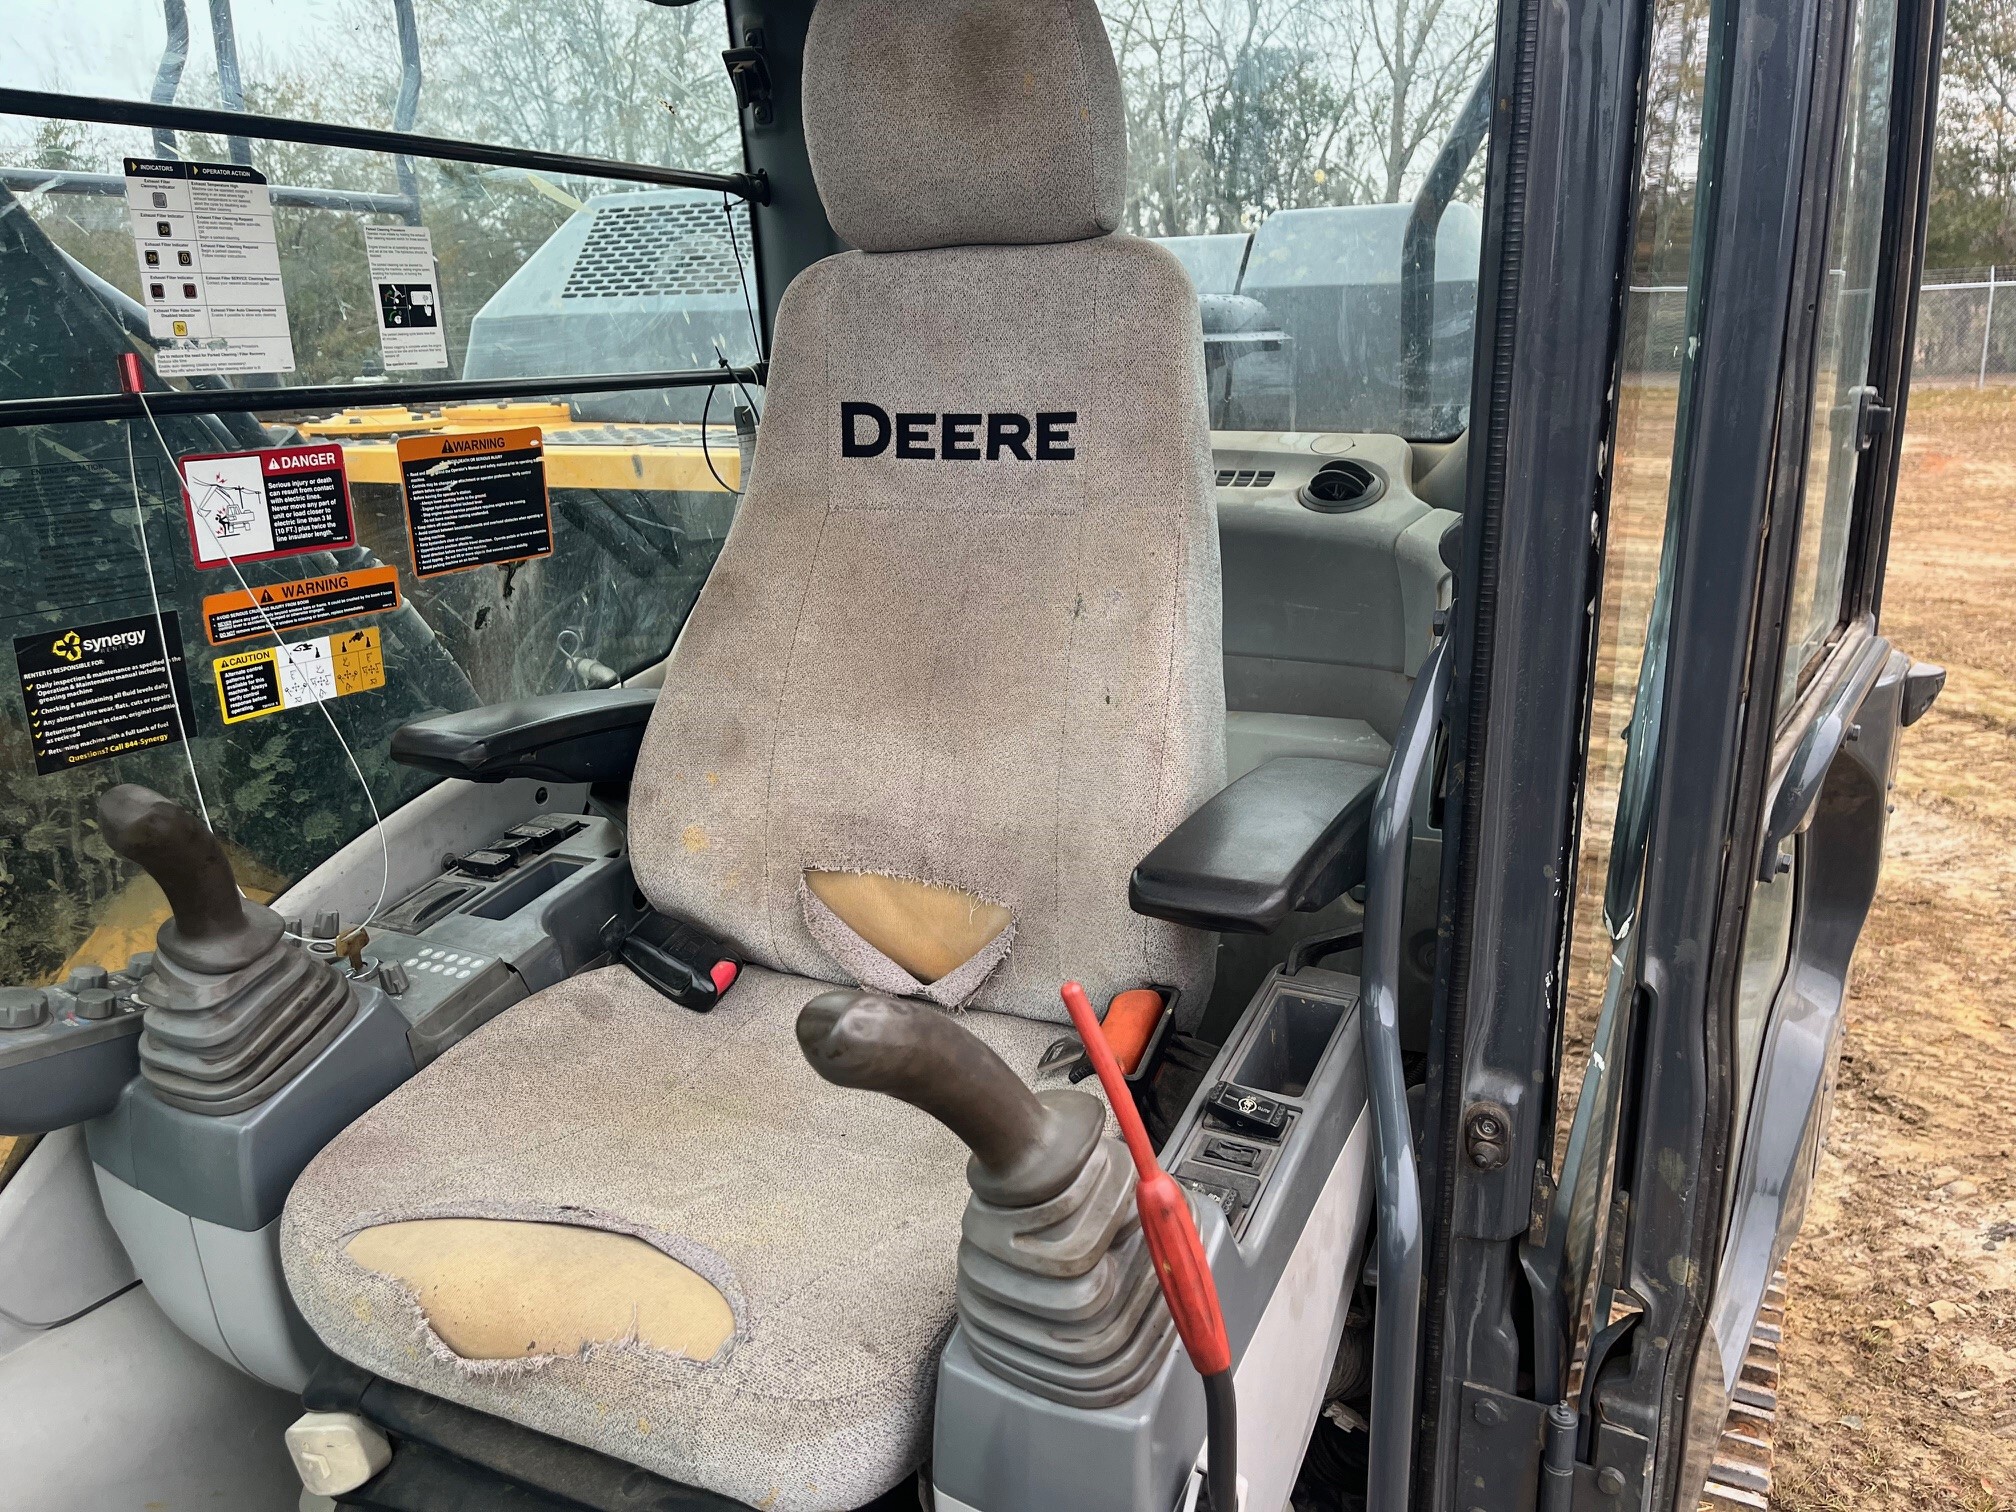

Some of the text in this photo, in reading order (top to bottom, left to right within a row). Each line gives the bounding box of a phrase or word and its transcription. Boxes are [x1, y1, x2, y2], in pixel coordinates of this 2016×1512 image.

[140, 164, 173, 172] INDICATORS
[202, 168, 230, 176] OPERATOR
[453, 437, 505, 452] WARNING
[281, 453, 336, 469] DANGER
[313, 484, 334, 492] contact
[284, 495, 306, 503] electric
[318, 499, 330, 508] part
[274, 519, 296, 527] electric
[275, 528, 285, 536] [10
[298, 525, 311, 533] plus
[288, 532, 314, 540] insulator
[314, 529, 334, 537] length.
[282, 576, 349, 599] WARNING
[83, 630, 146, 652] synergy
[229, 651, 270, 666] CAUTION
[23, 671, 46, 680] RENTER
[53, 662, 91, 674] RESPONSIBLE
[53, 676, 86, 686] inspection
[92, 667, 131, 678] maintenance
[139, 659, 165, 669] specified
[224, 665, 264, 678] Alternate control
[38, 686, 69, 696] Operation
[76, 677, 115, 688] Maintenance
[115, 671, 138, 680] manual
[138, 667, 165, 675] including
[226, 676, 245, 685] patterns
[227, 681, 248, 690] available
[39, 688, 93, 704] greasing machine
[228, 683, 268, 697] machine. Always
[243, 690, 260, 699] control
[41, 704, 70, 714] Checking
[76, 695, 113, 707] maintaining
[122, 689, 136, 697] fluid
[136, 686, 153, 694] levels
[230, 700, 252, 709] response
[252, 695, 267, 703] before
[56, 712, 86, 723] abnormal
[151, 694, 170, 702] repairs
[231, 705, 254, 715] operating.
[45, 726, 76, 737] Returning
[76, 720, 102, 730] machine
[128, 708, 151, 718] original
[152, 703, 178, 712] conditio
[54, 731, 81, 742] recieved
[80, 738, 106, 747] machine
[107, 733, 120, 741] with
[136, 726, 150, 734] tank
[68, 734, 169, 763] Questions? Call 844-Synergy
